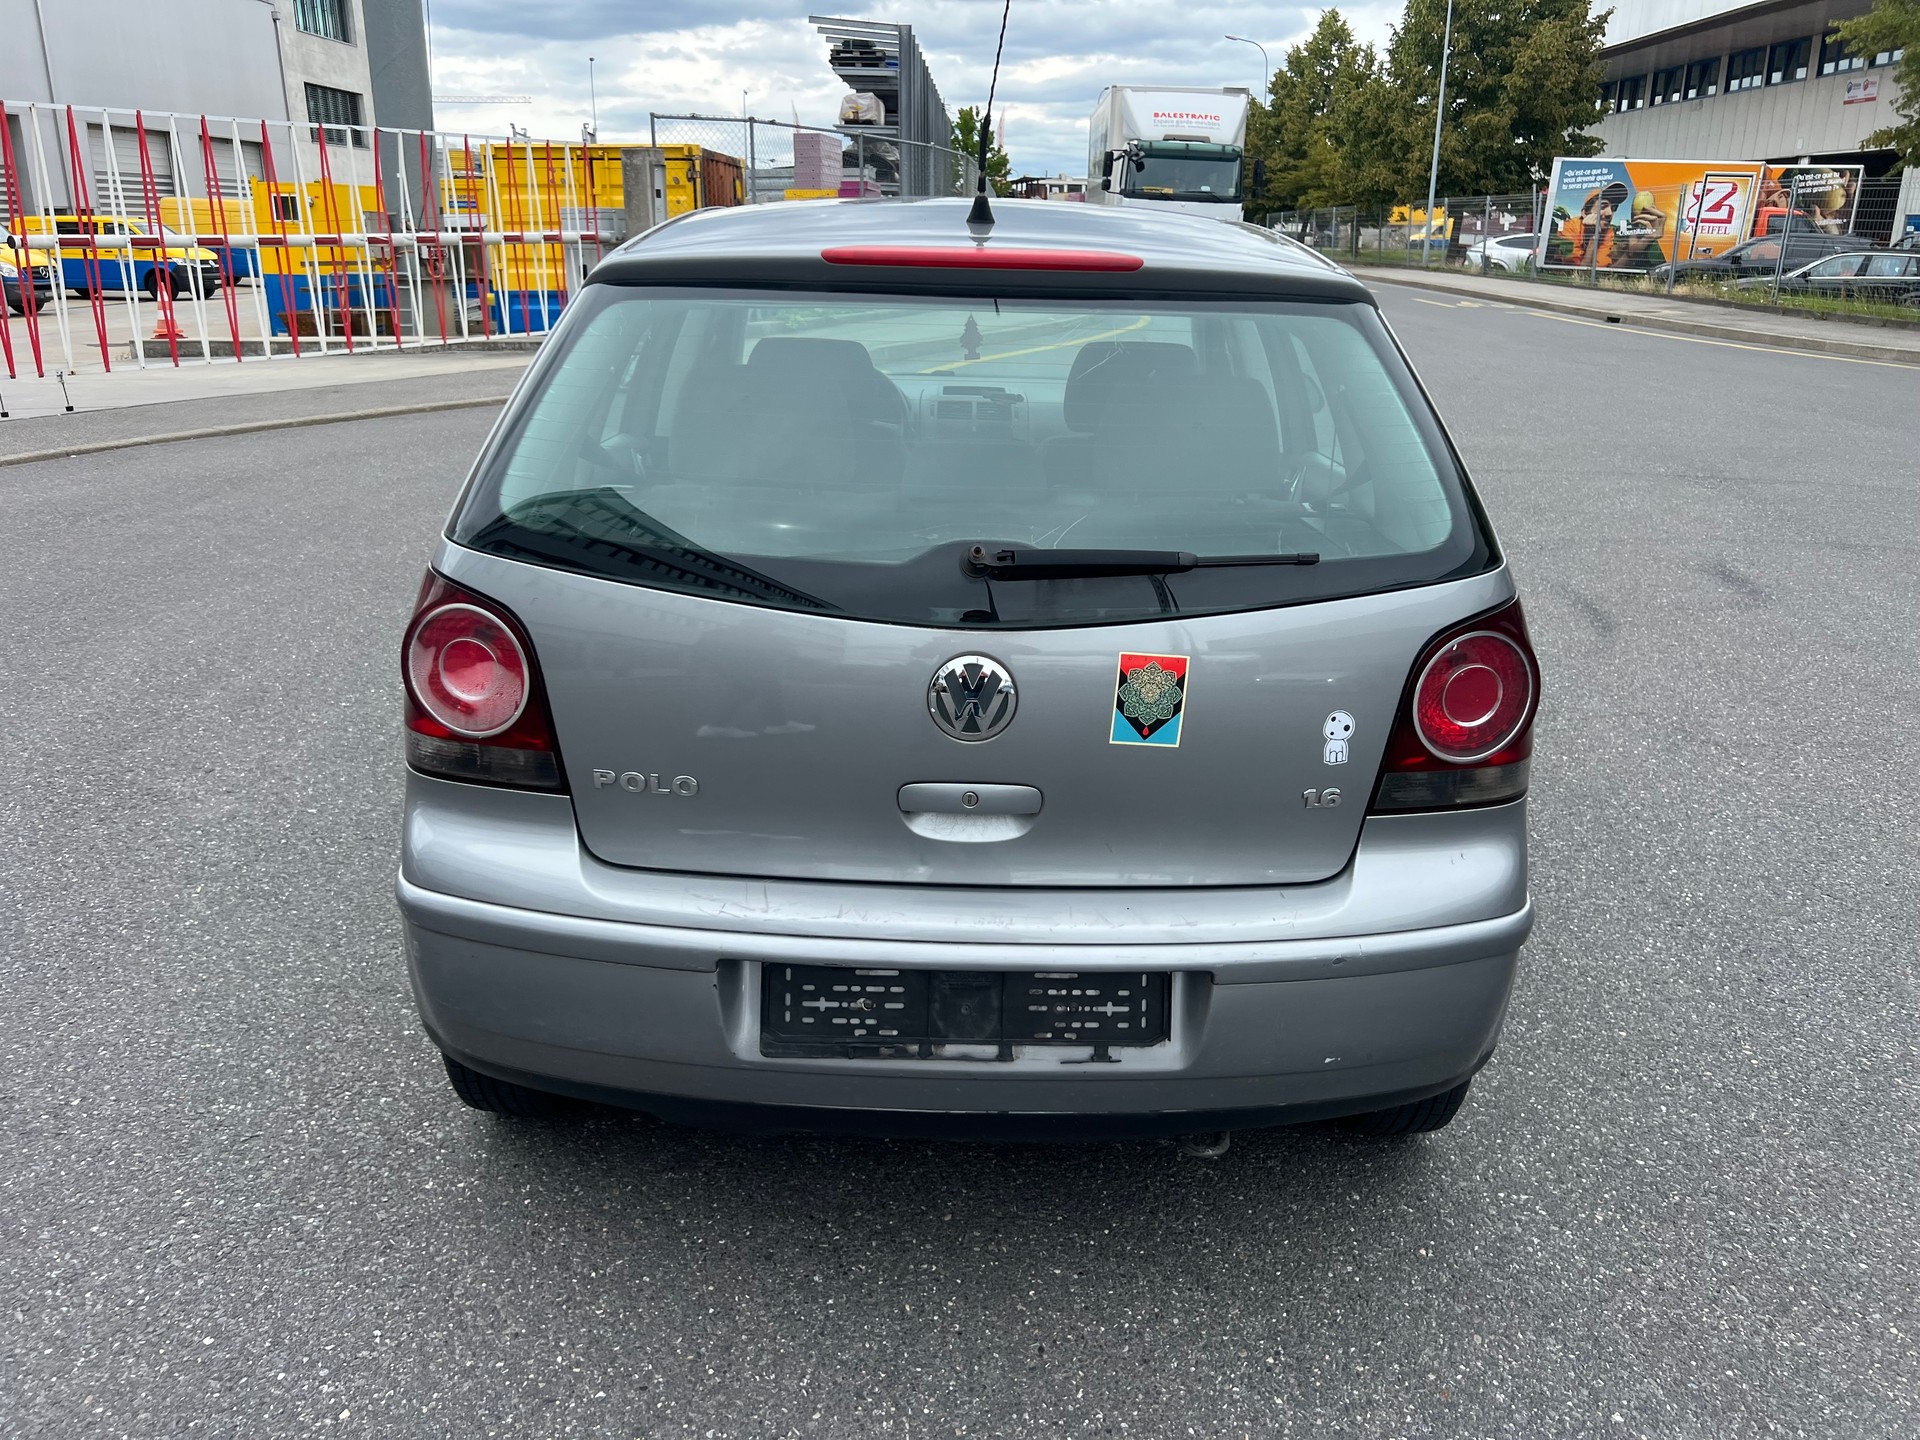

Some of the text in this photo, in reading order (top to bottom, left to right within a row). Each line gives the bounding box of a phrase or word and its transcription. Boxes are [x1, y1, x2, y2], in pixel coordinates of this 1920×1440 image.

[1153, 112, 1220, 121] BALESTRAFIC
[1596, 173, 1613, 181] quand
[1582, 181, 1600, 189] grande
[593, 768, 699, 797] POLO
